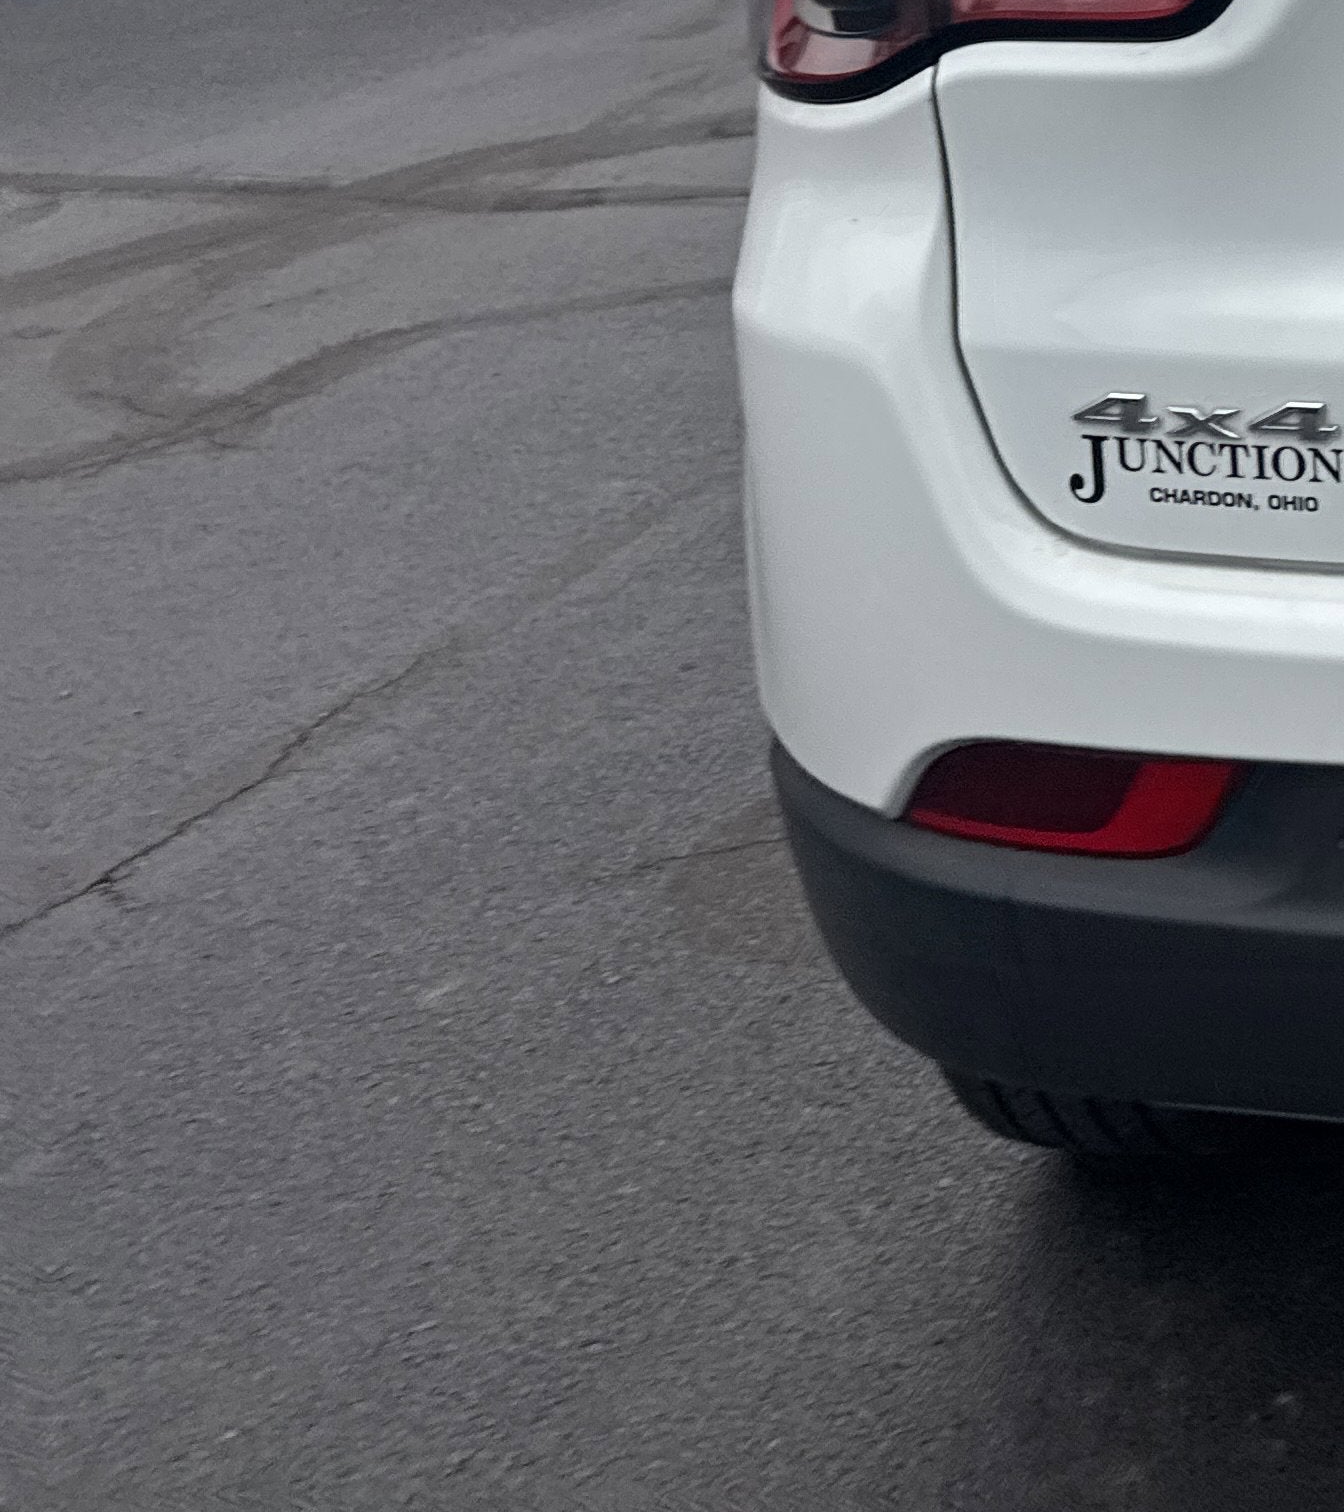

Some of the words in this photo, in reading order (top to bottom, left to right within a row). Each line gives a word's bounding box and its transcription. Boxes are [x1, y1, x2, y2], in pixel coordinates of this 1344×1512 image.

[1071, 391, 1342, 441] 4x4
[1069, 434, 1344, 503] JUNCTION
[1150, 487, 1260, 510] CHARDON,
[1267, 494, 1319, 512] OHIO
